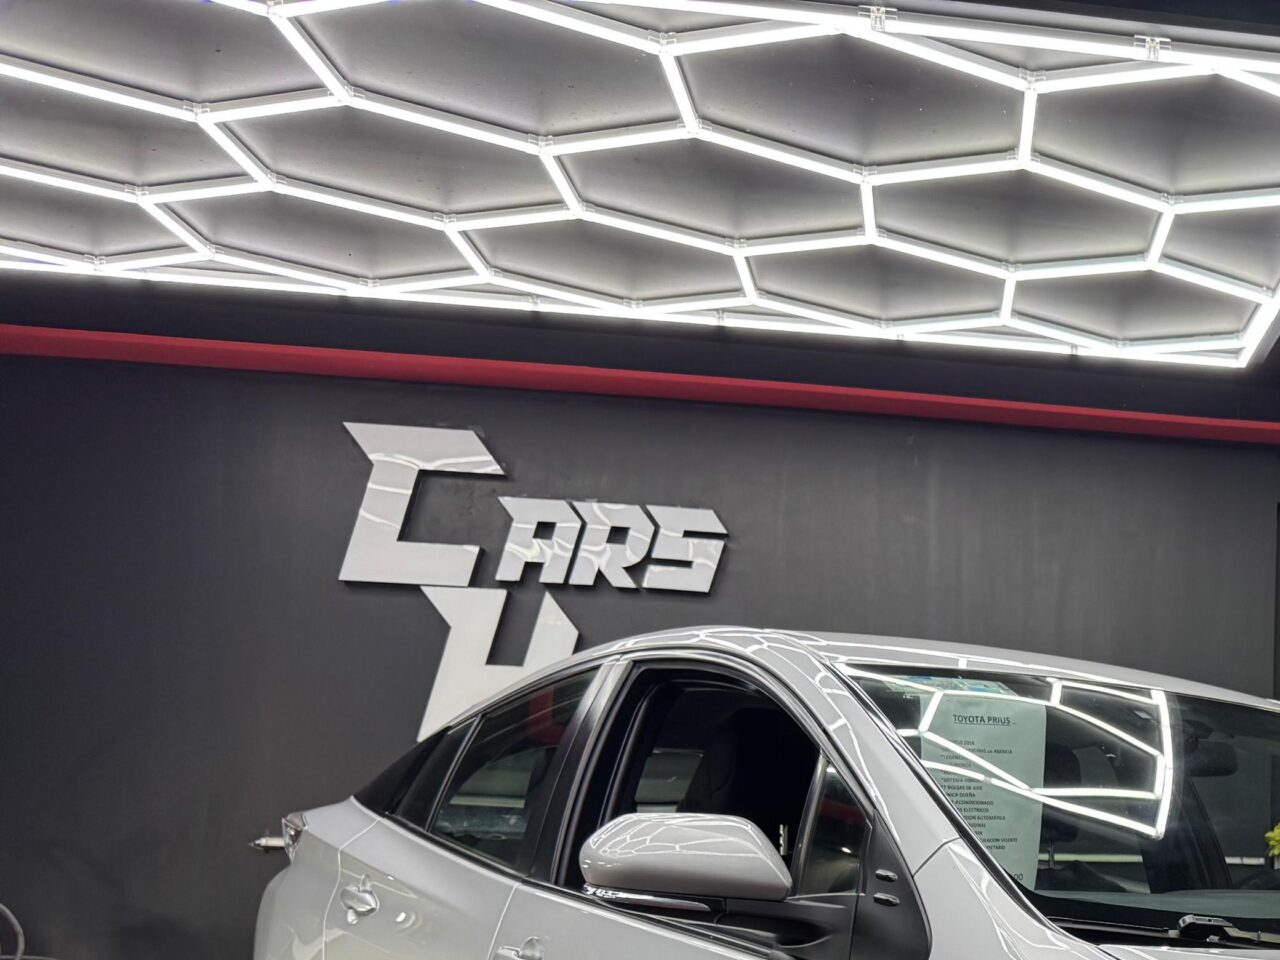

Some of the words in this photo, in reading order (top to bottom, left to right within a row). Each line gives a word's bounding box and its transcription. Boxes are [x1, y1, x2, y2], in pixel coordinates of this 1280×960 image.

[338, 421, 728, 593] CARS
[953, 714, 986, 723] TOYOTA
[987, 716, 1011, 725] PRIUS
